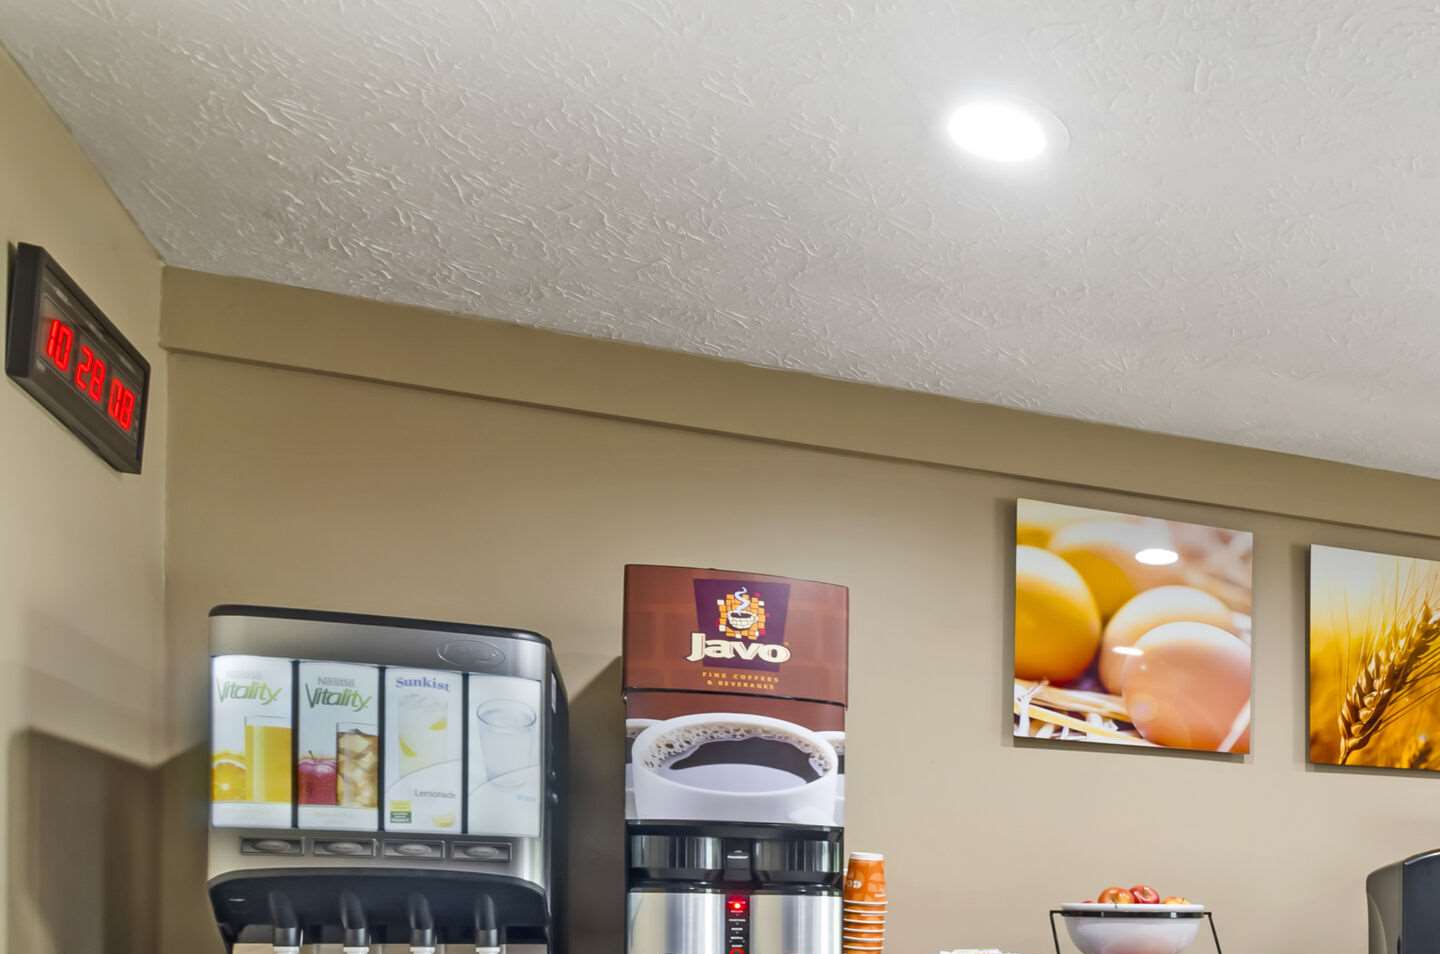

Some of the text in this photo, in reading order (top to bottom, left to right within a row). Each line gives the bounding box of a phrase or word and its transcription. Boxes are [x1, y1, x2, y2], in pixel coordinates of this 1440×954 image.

[46, 318, 73, 372] 10
[686, 632, 791, 663] Javo
[216, 679, 283, 705] Vitality
[305, 683, 373, 712] Vitality
[395, 676, 449, 692] Sunkist
